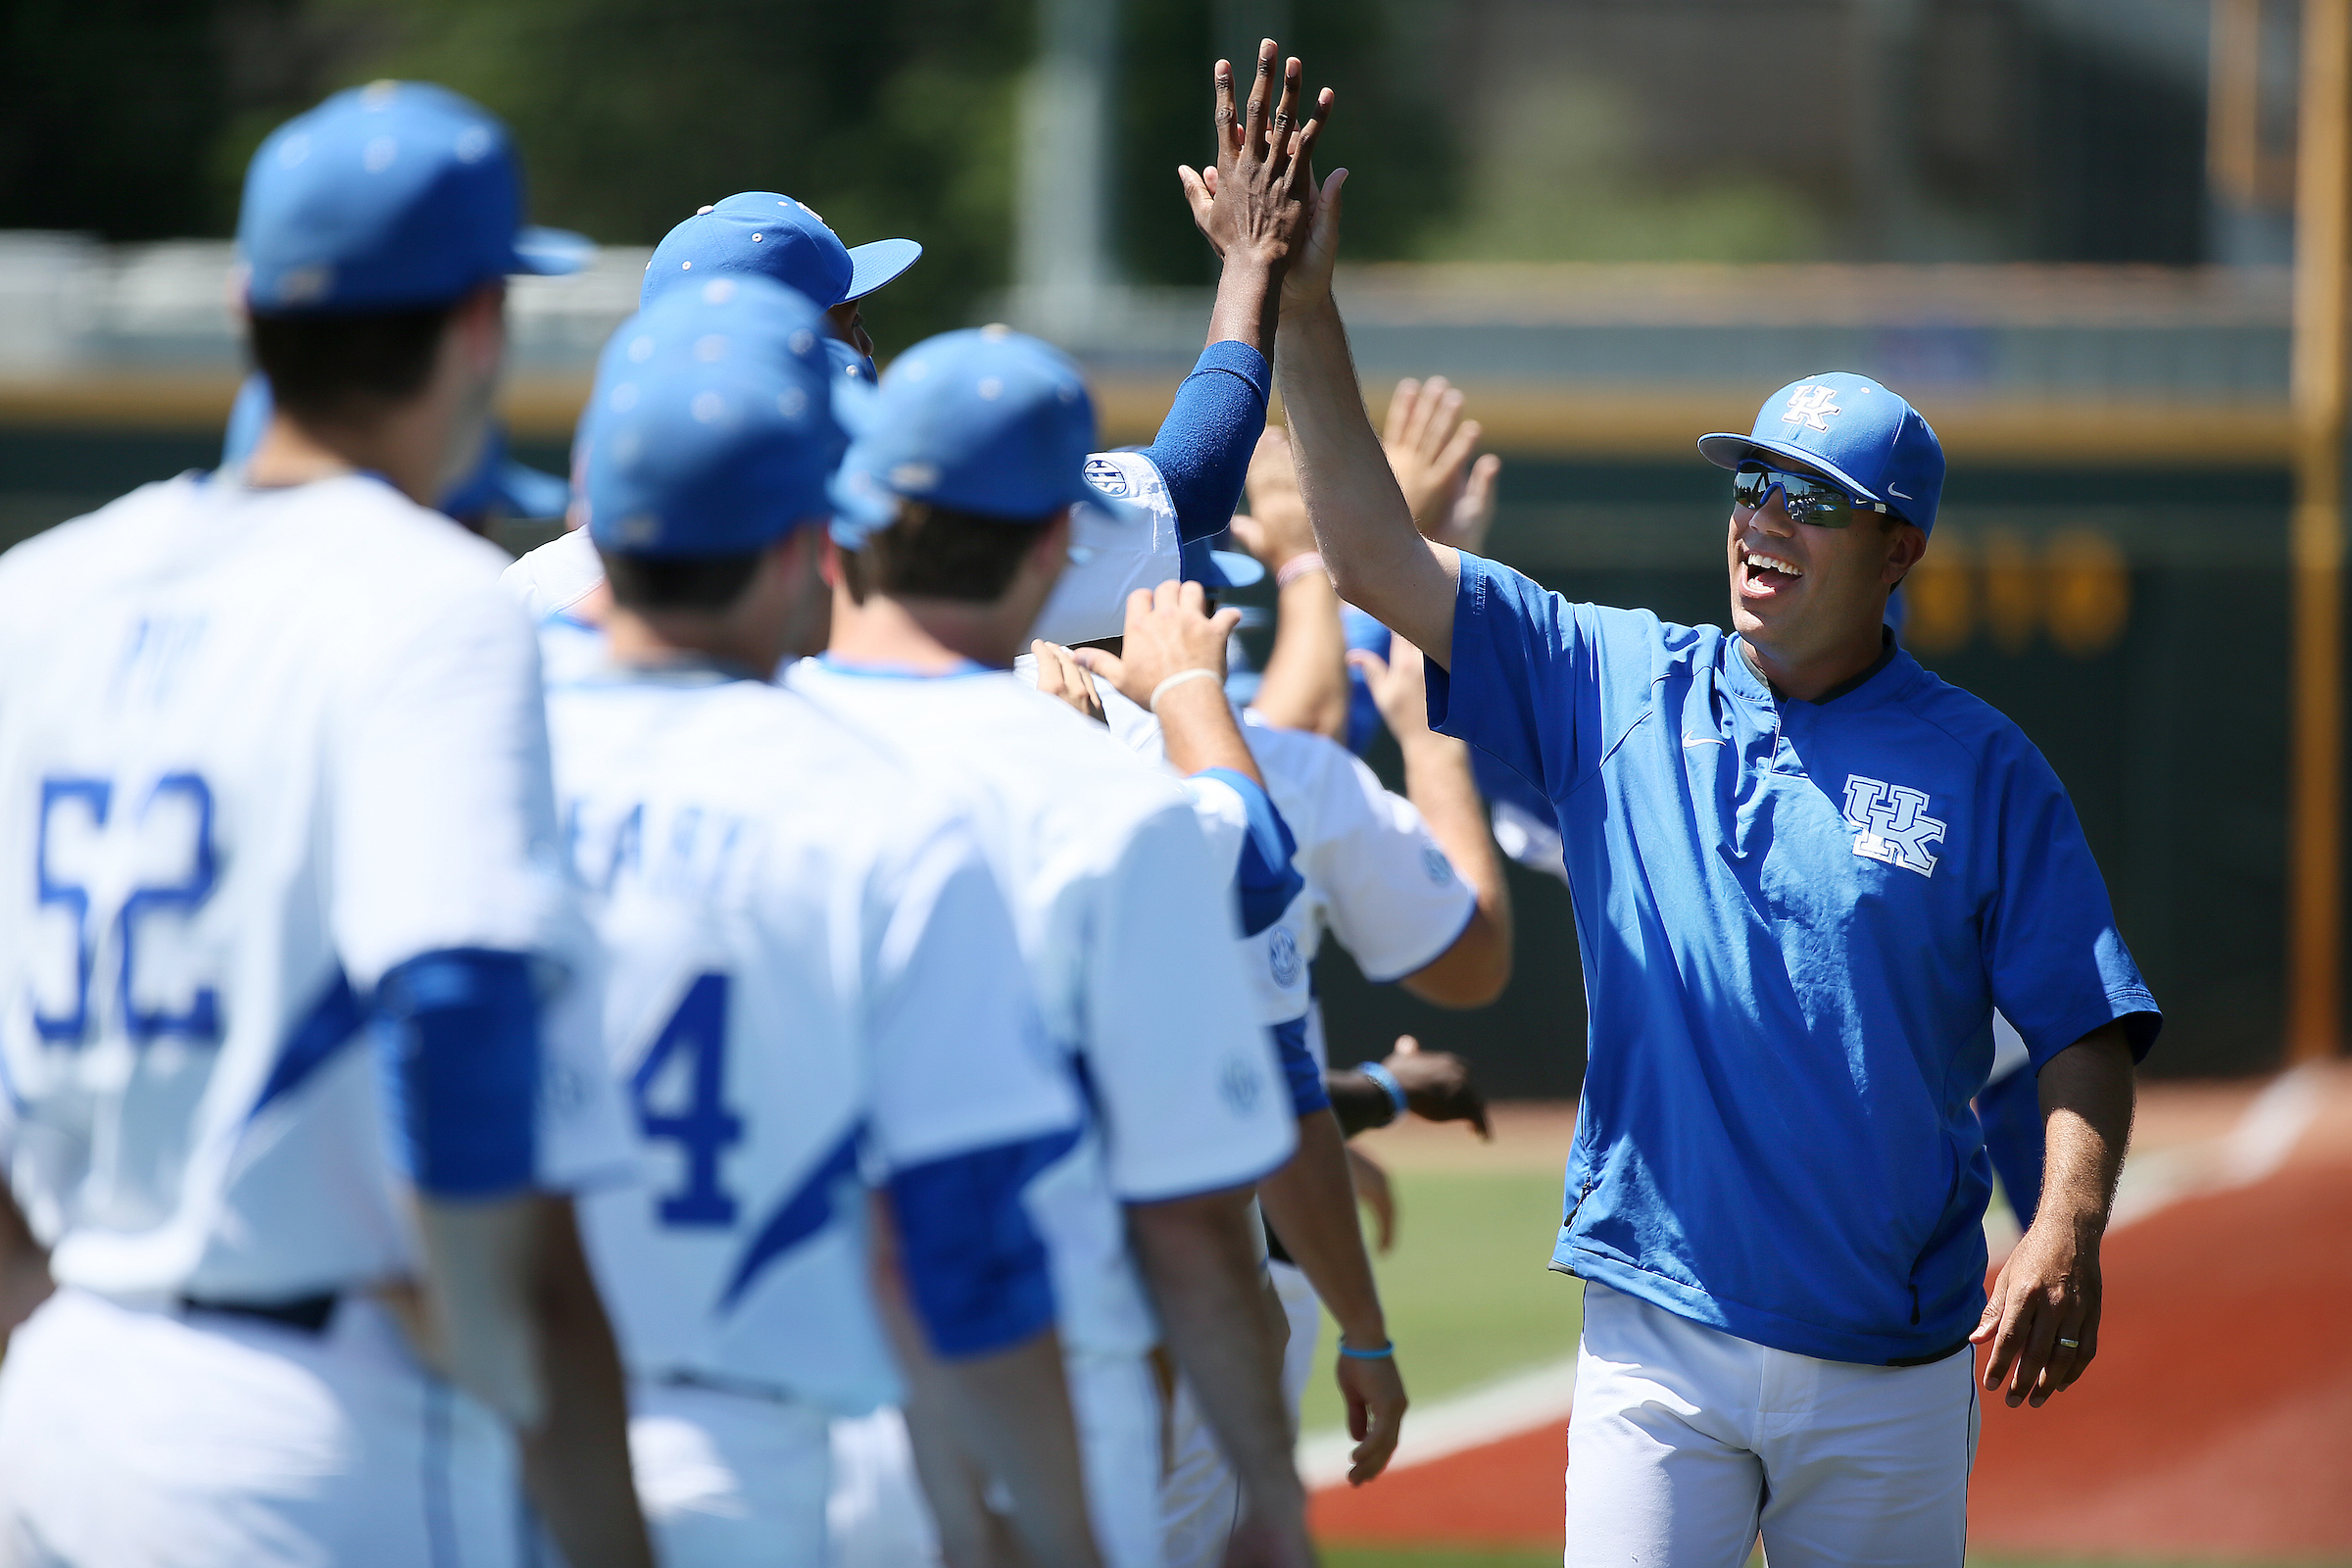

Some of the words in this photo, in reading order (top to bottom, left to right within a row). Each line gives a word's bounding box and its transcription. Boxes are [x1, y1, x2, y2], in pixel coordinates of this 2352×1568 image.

[1781, 385, 1842, 433] UK
[35, 770, 218, 1041] 52
[1842, 773, 1948, 879] UK
[625, 970, 745, 1225] 4
